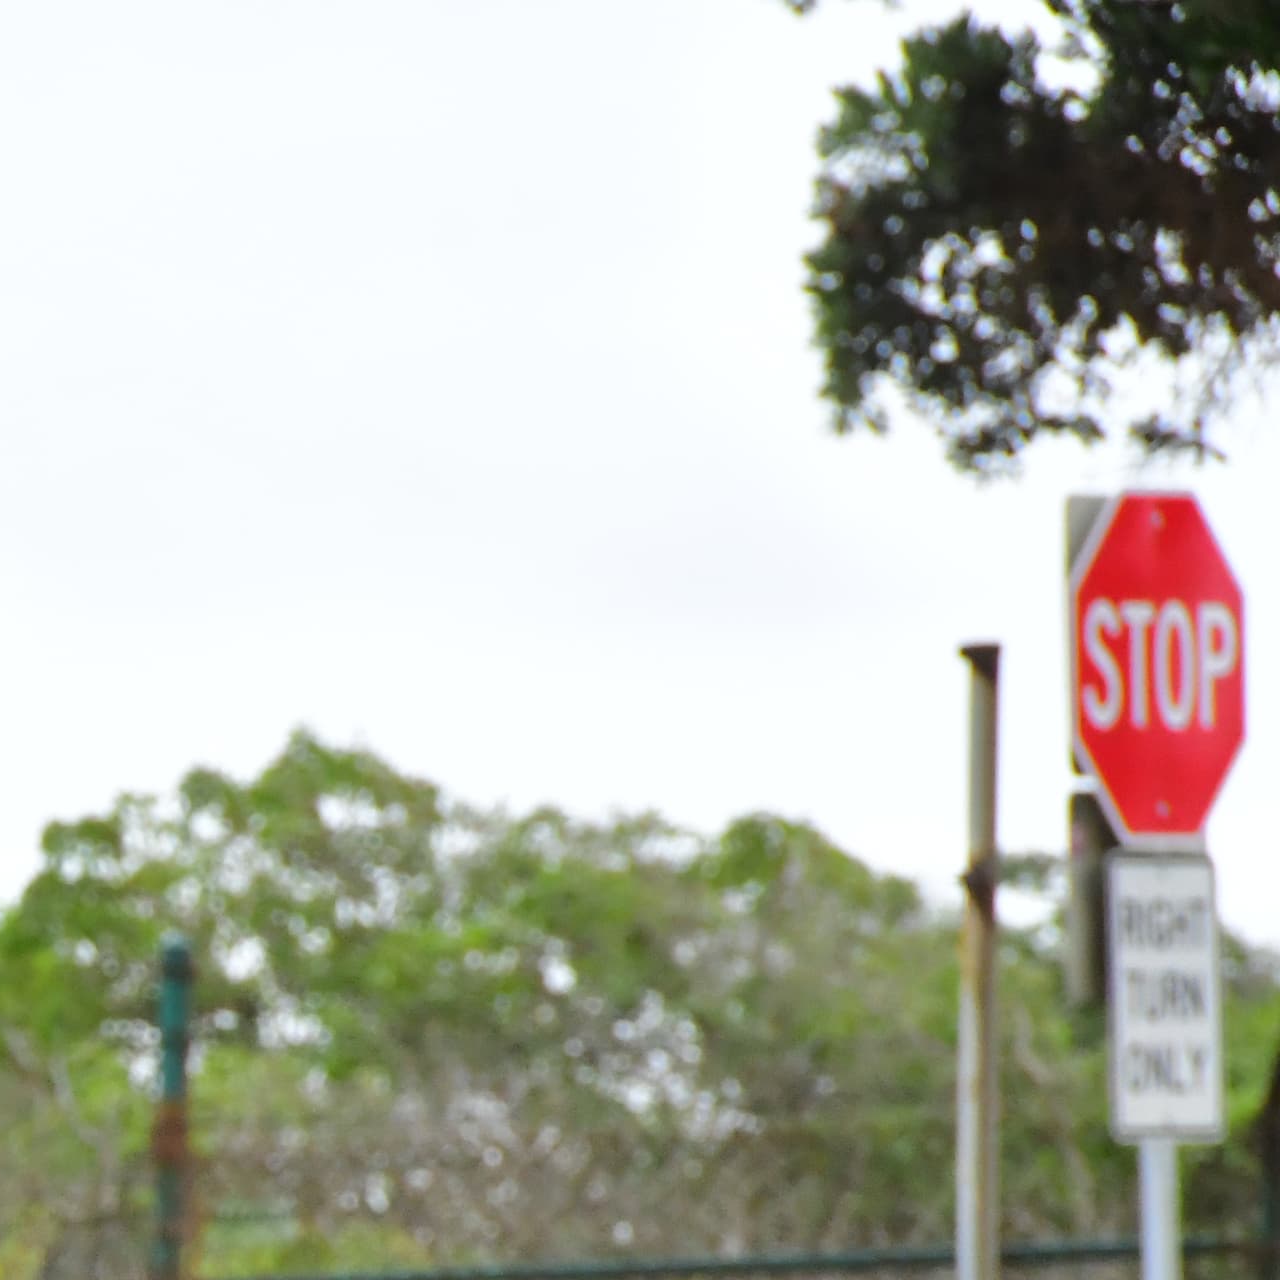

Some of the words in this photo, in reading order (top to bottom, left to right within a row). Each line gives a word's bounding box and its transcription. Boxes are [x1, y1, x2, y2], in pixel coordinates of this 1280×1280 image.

[1082, 599, 1238, 731] STOP
[1118, 896, 1207, 947] RIGHT
[1126, 968, 1206, 1021] TURN
[1123, 1040, 1209, 1094] ONLY
